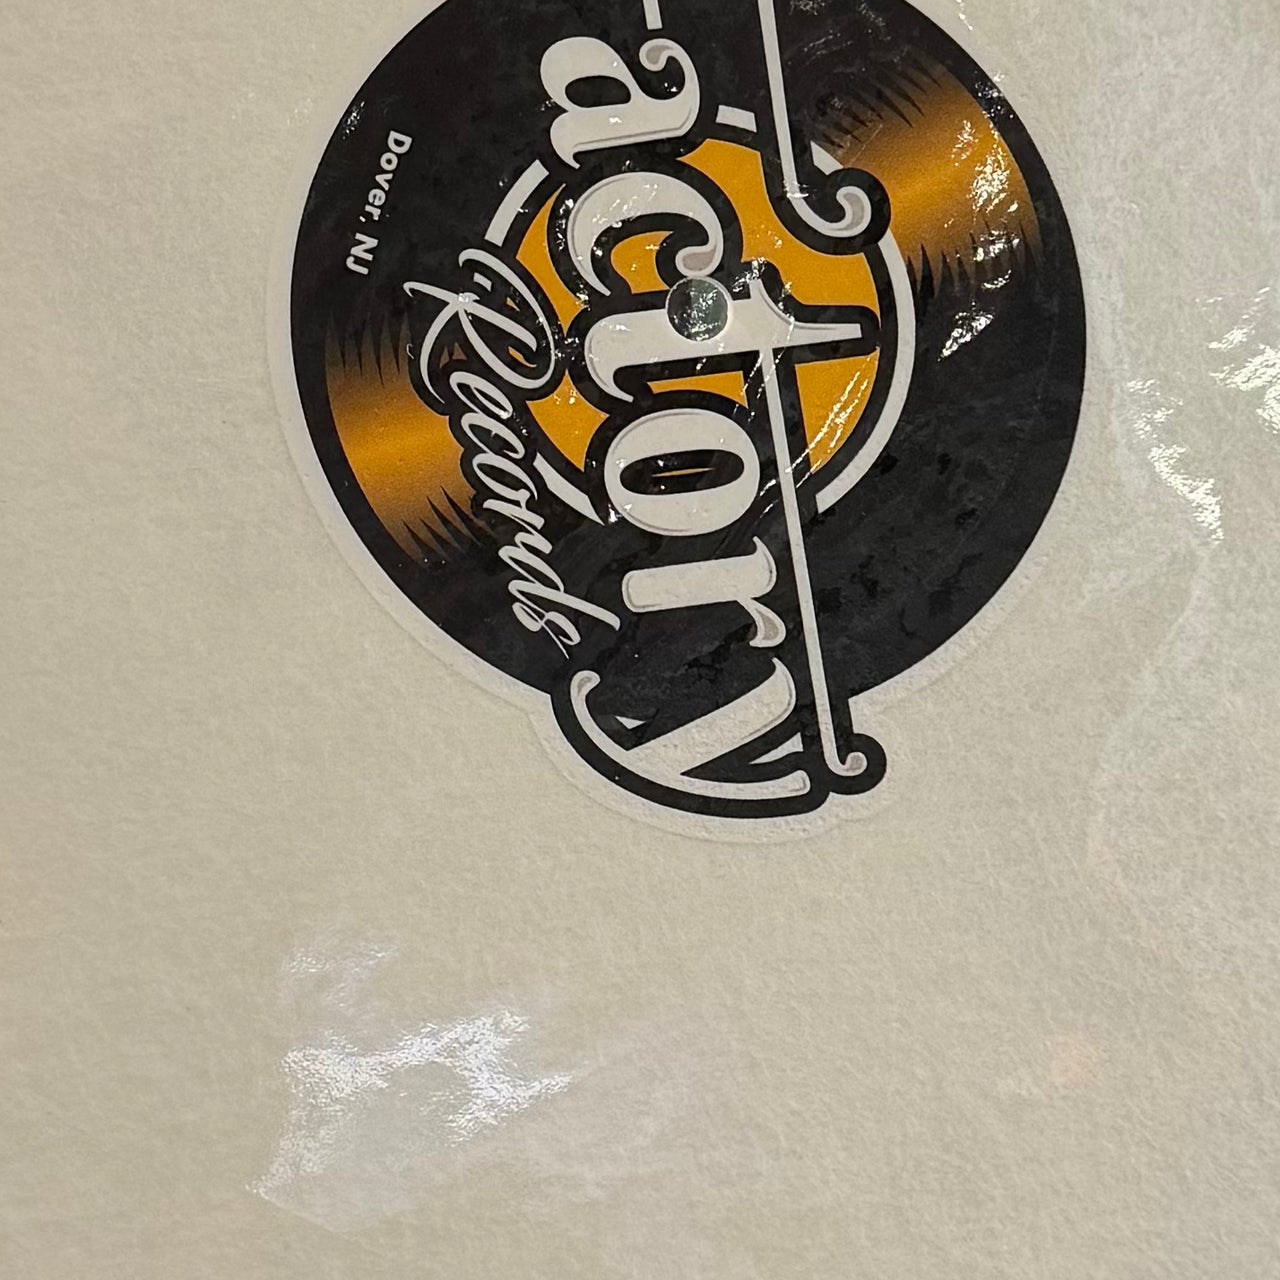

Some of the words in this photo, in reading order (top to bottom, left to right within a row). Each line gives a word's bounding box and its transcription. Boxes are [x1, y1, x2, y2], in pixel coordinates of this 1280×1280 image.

[359, 129, 413, 223] Dover,
[345, 232, 380, 276] NJ
[401, 246, 622, 660] Records
